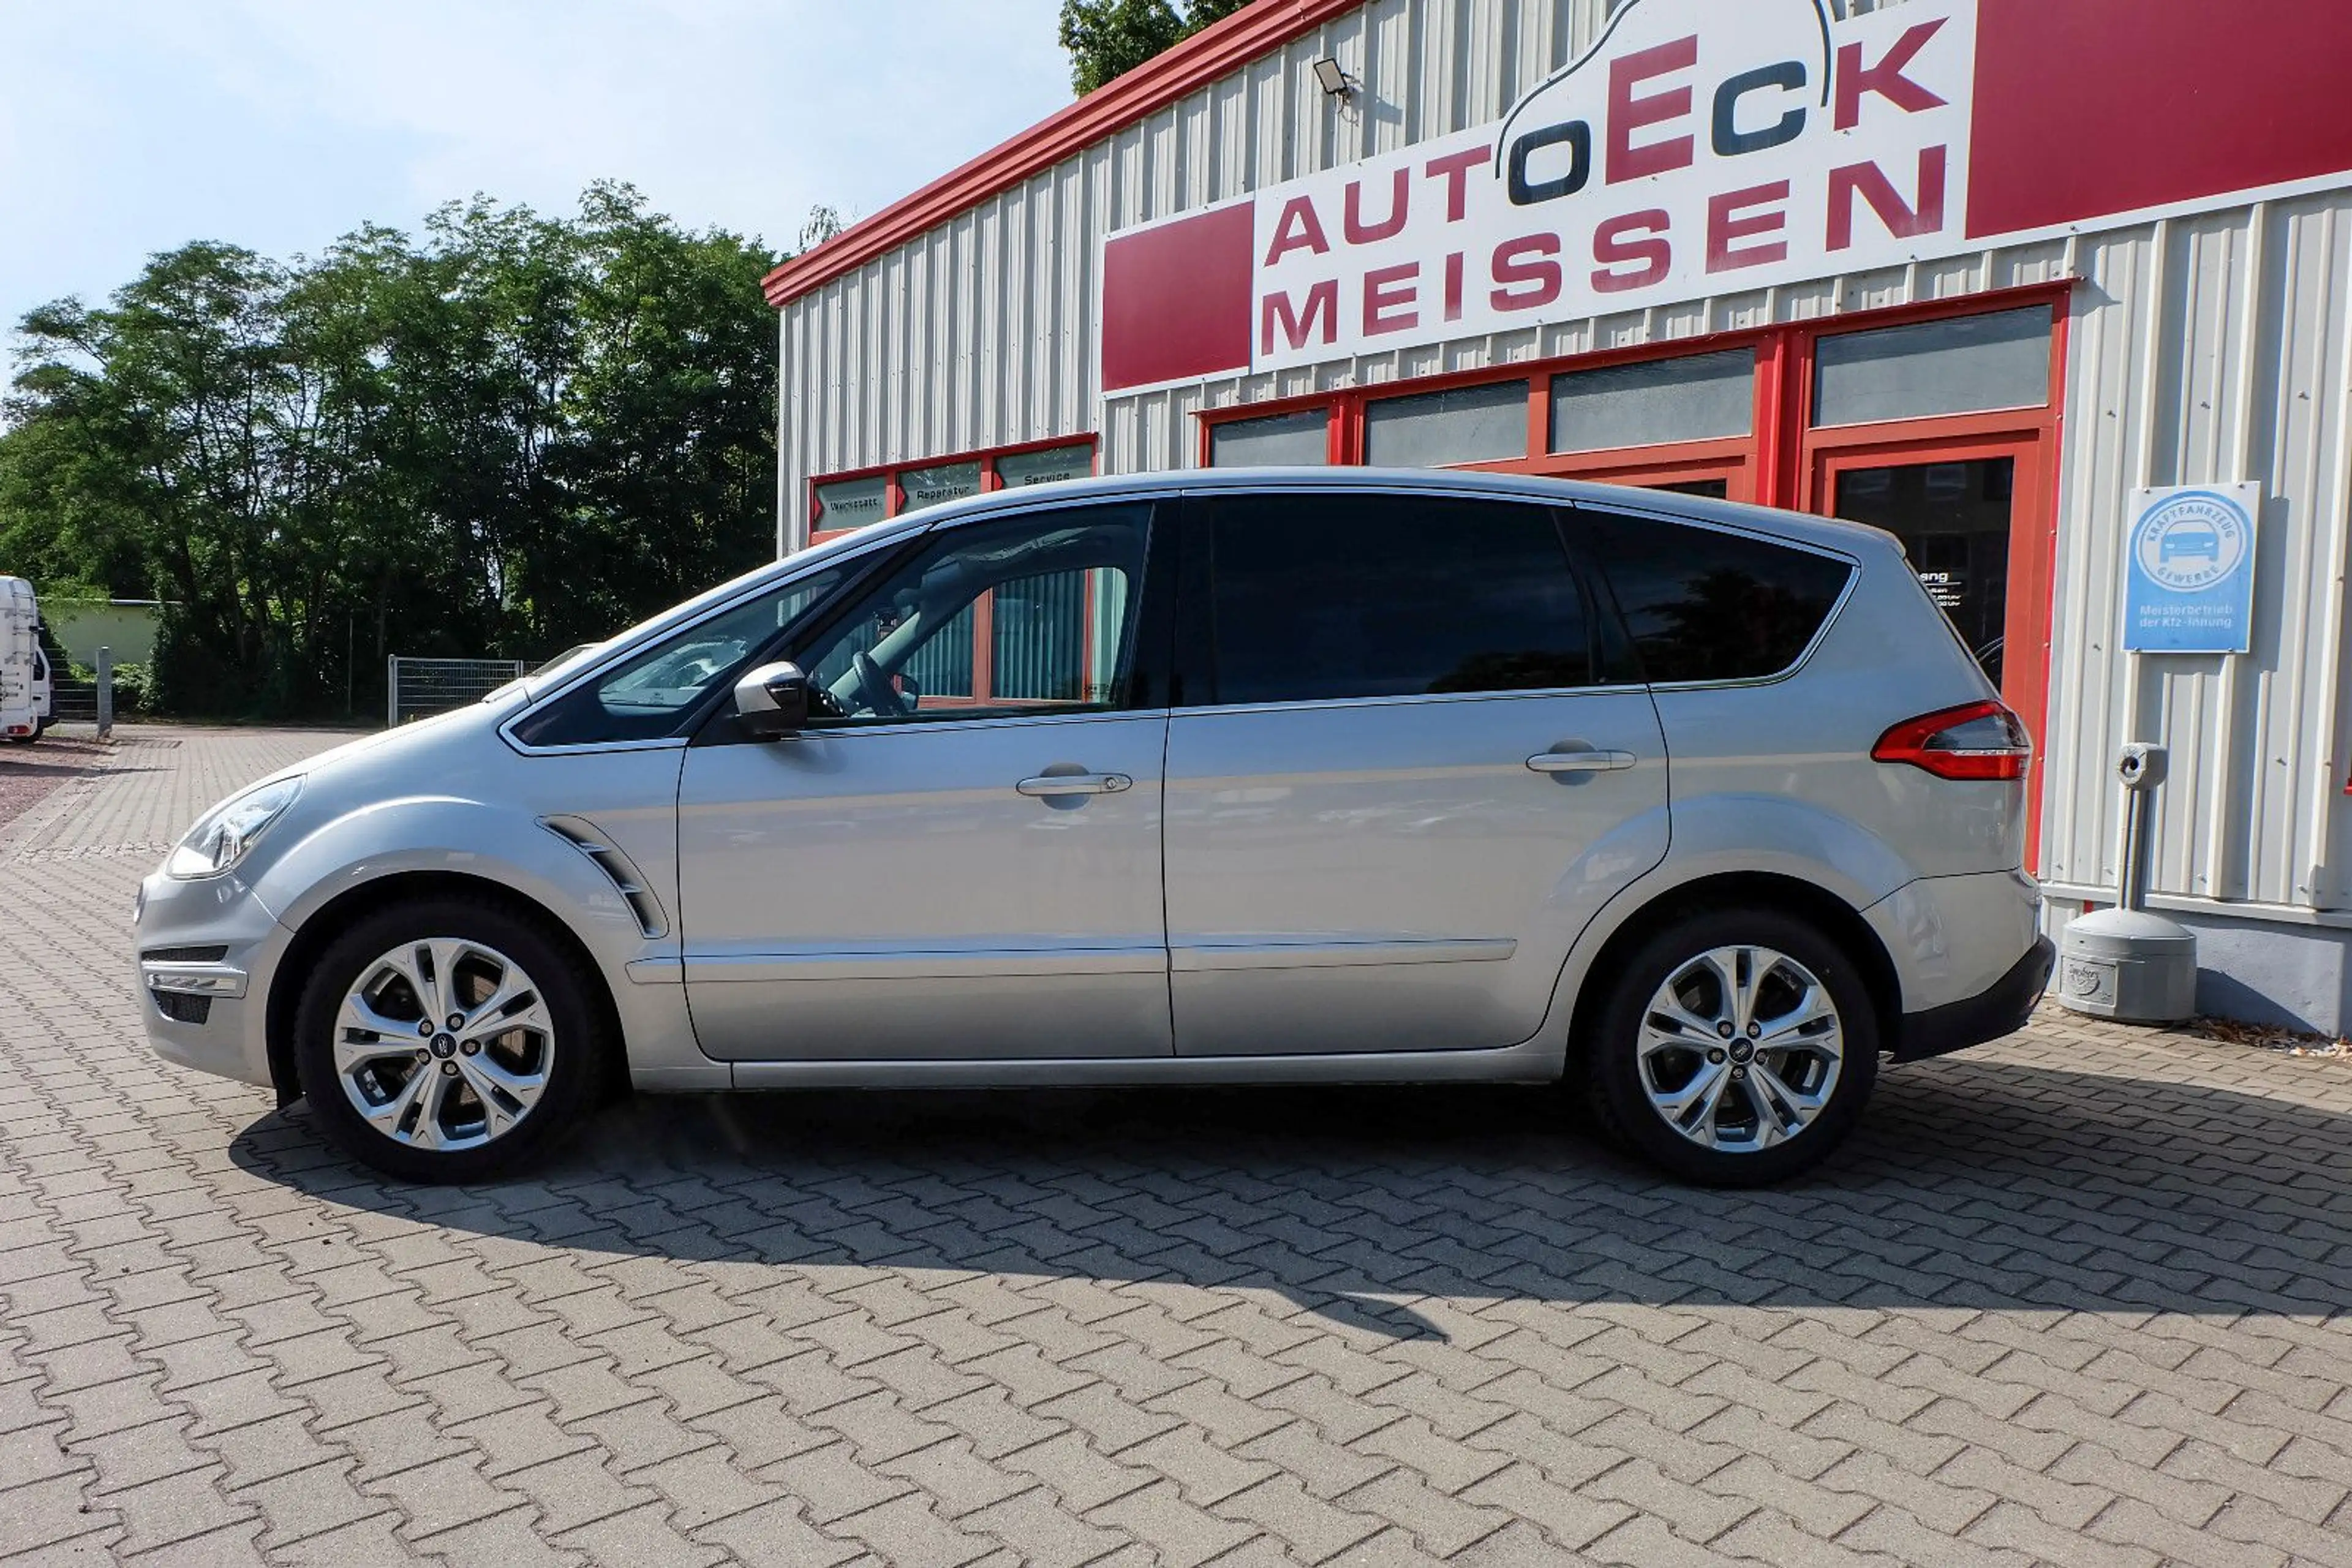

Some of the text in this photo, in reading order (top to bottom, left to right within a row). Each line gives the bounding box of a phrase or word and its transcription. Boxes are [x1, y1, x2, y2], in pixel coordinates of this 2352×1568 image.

[1261, 144, 1947, 356] MEISSEN
[1024, 470, 1071, 486] Service
[917, 485, 970, 500] Reparatur
[1920, 572, 1948, 582] ang
[2139, 604, 2233, 616] Meisterbetrieb
[2140, 616, 2159, 627] der
